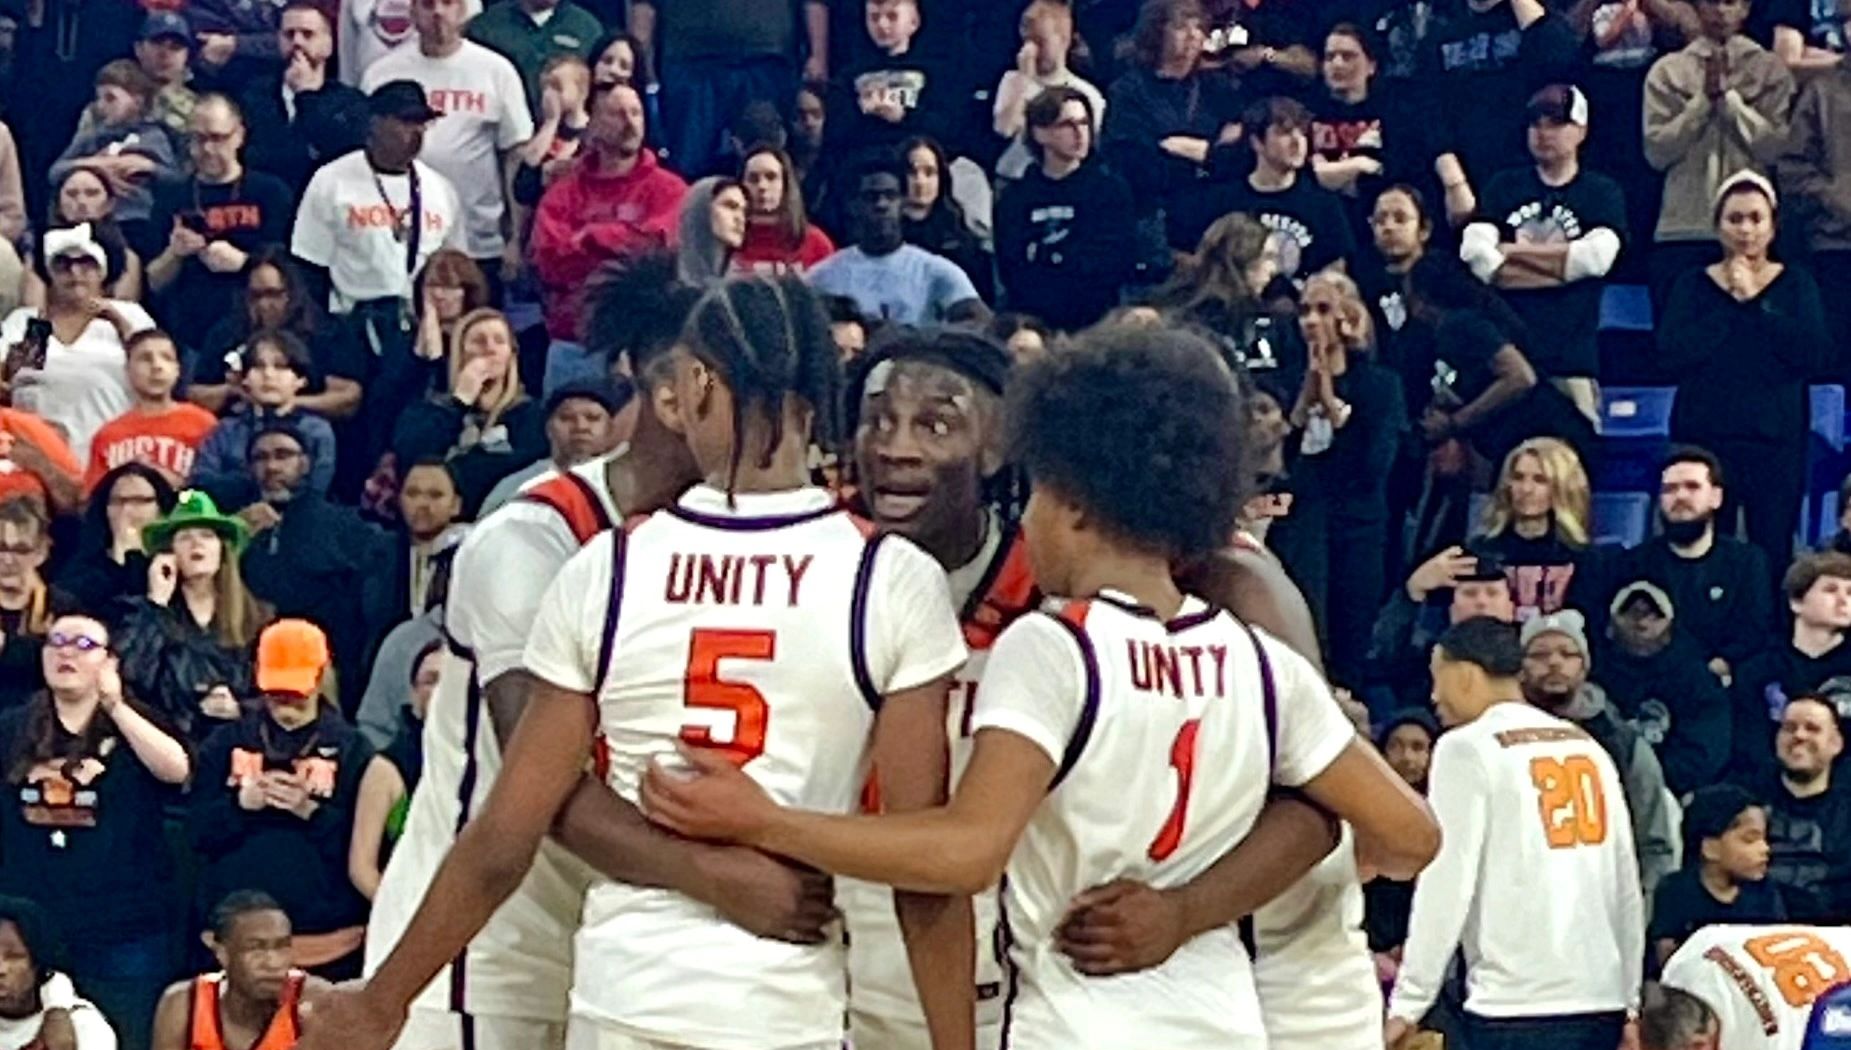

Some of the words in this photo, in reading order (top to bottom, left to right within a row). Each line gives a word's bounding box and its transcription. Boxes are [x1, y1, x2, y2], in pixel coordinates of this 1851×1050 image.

[665, 552, 814, 607] UNITY
[678, 627, 777, 769] 5
[1146, 718, 1201, 863] 1
[1529, 754, 1608, 849] 20
